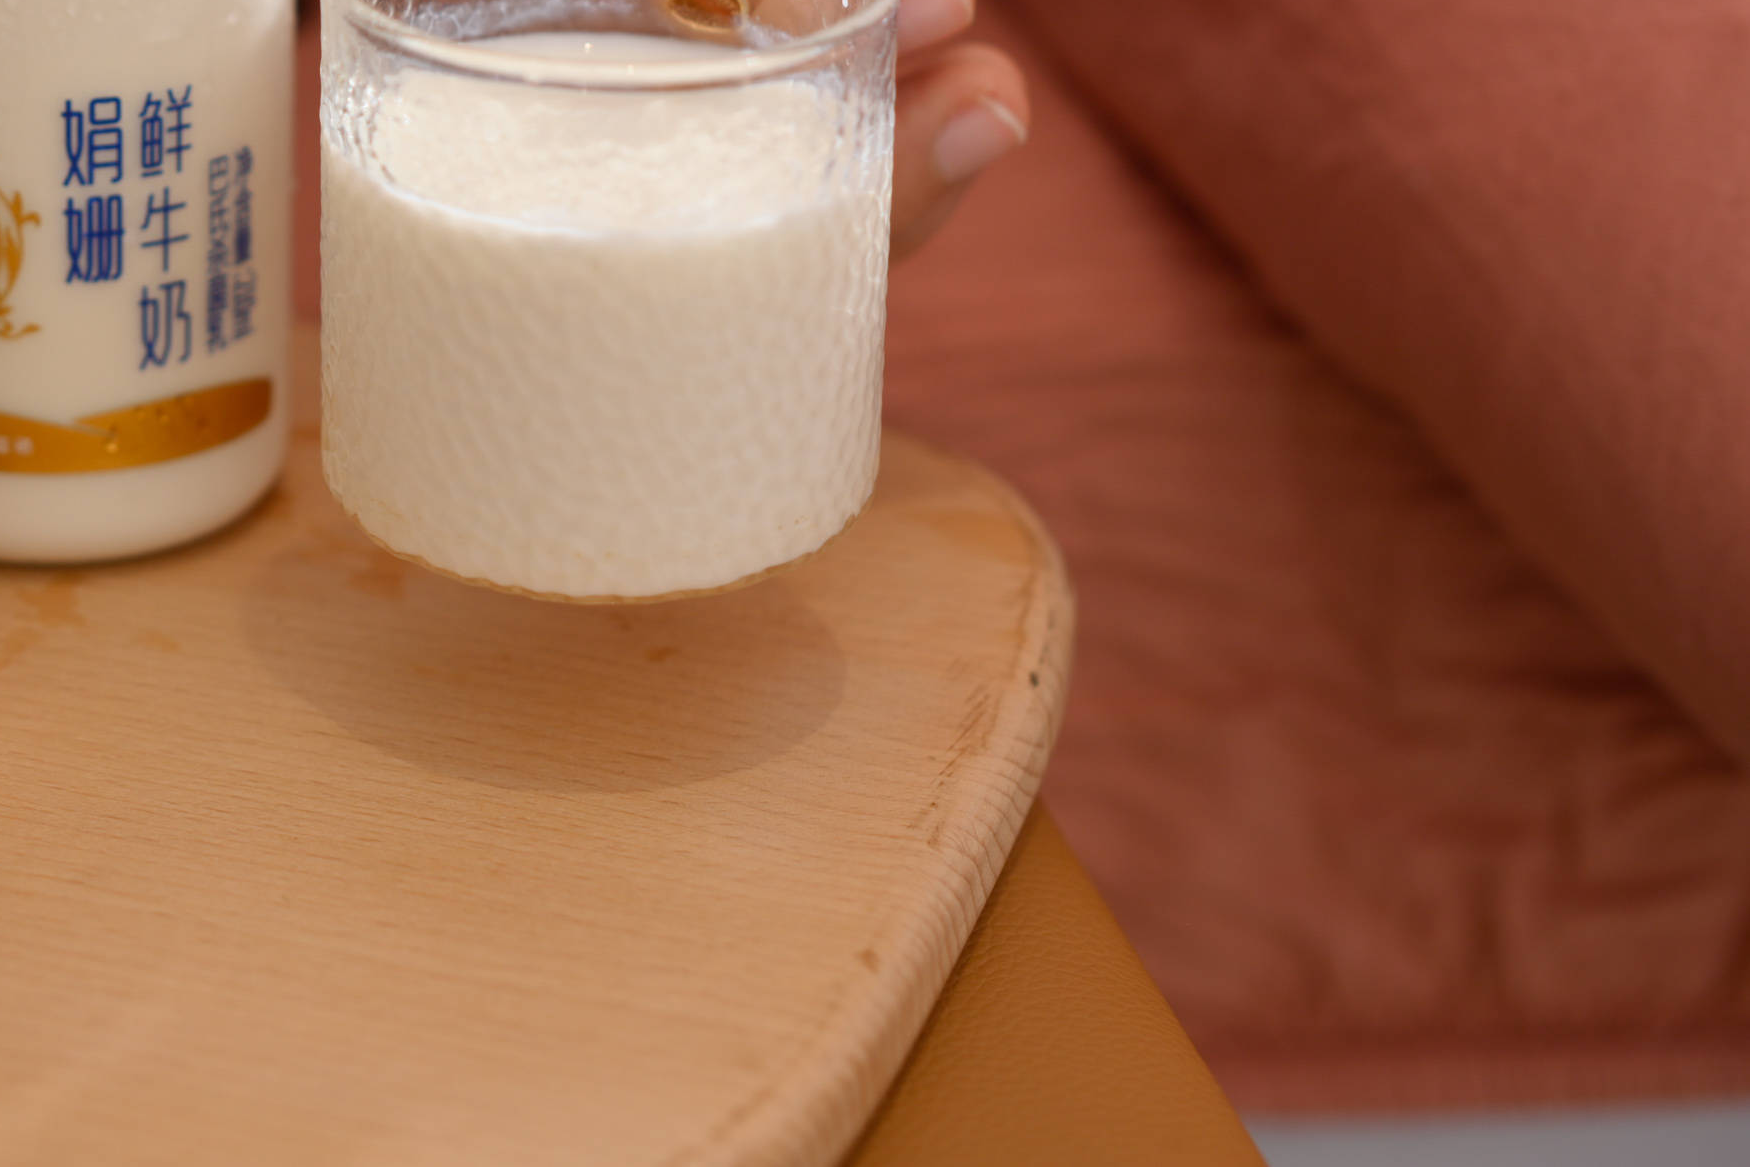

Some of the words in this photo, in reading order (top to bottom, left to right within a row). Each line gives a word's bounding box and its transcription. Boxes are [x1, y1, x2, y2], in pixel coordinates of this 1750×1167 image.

[62, 96, 124, 284] 娟姗
[139, 84, 193, 371] 鲜牛奶
